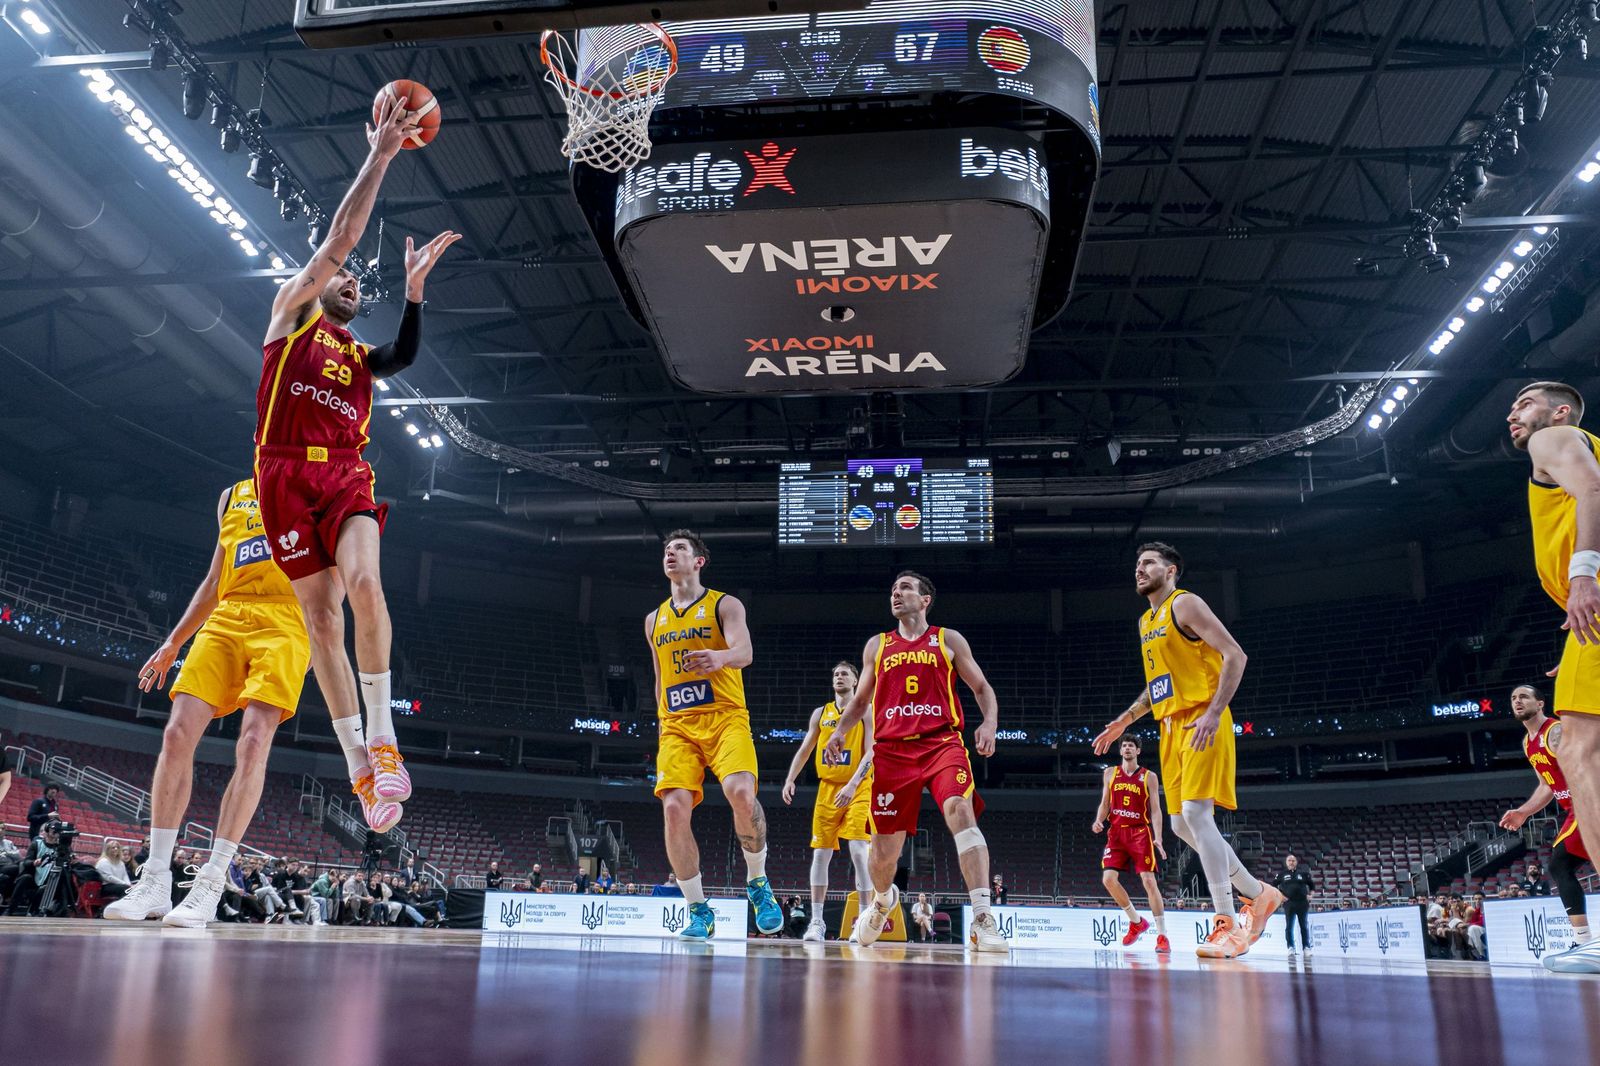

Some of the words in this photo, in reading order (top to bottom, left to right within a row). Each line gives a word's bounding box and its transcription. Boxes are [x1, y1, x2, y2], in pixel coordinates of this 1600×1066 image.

[895, 33, 939, 62] 67
[700, 44, 744, 73] 49
[998, 77, 1034, 95] SPAIN
[657, 194, 735, 212] SPORTS
[795, 272, 940, 295] XIAOMI
[744, 335, 875, 352] XIAOMI
[321, 358, 352, 386] 29
[290, 382, 357, 421] endesa
[857, 465, 874, 478] 49
[895, 464, 911, 478] 67
[656, 627, 711, 647] UKRAINE
[1467, 635, 1484, 646] 311
[883, 650, 938, 673] ESPAÑA
[1147, 649, 1155, 671] 5
[905, 675, 919, 694] 6
[1152, 678, 1169, 700] BGV
[669, 684, 706, 707] BGV
[886, 701, 942, 720] endesa
[1434, 702, 1480, 716] betsafe
[575, 718, 611, 731] betsafe
[1542, 771, 1555, 785] 10
[1114, 783, 1141, 796] ESPAÑA
[1123, 796, 1130, 806] 5
[1113, 809, 1140, 820] endesa
[579, 838, 598, 848] 107
